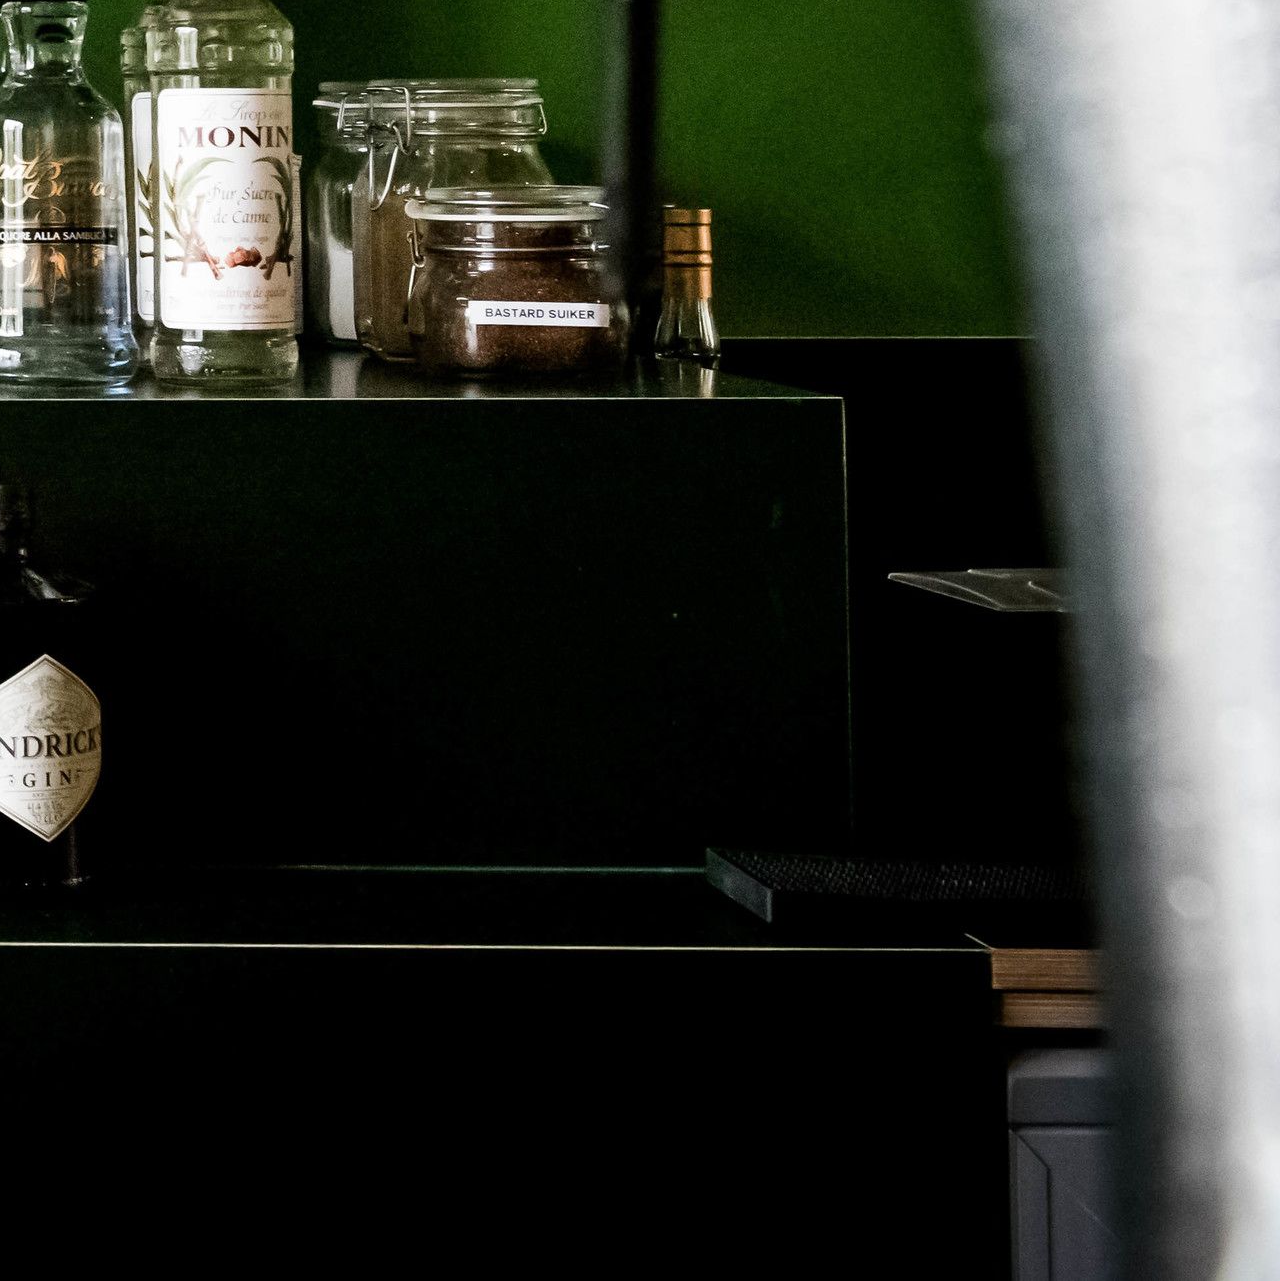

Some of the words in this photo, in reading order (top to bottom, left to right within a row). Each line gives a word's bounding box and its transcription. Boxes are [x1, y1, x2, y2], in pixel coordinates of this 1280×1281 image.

[178, 125, 290, 148] MONIN
[231, 209, 272, 225] Canne
[33, 231, 61, 242] ALLA
[485, 308, 545, 319] BASTARD
[548, 309, 596, 320] SUIKER
[22, 770, 73, 788] GIN
